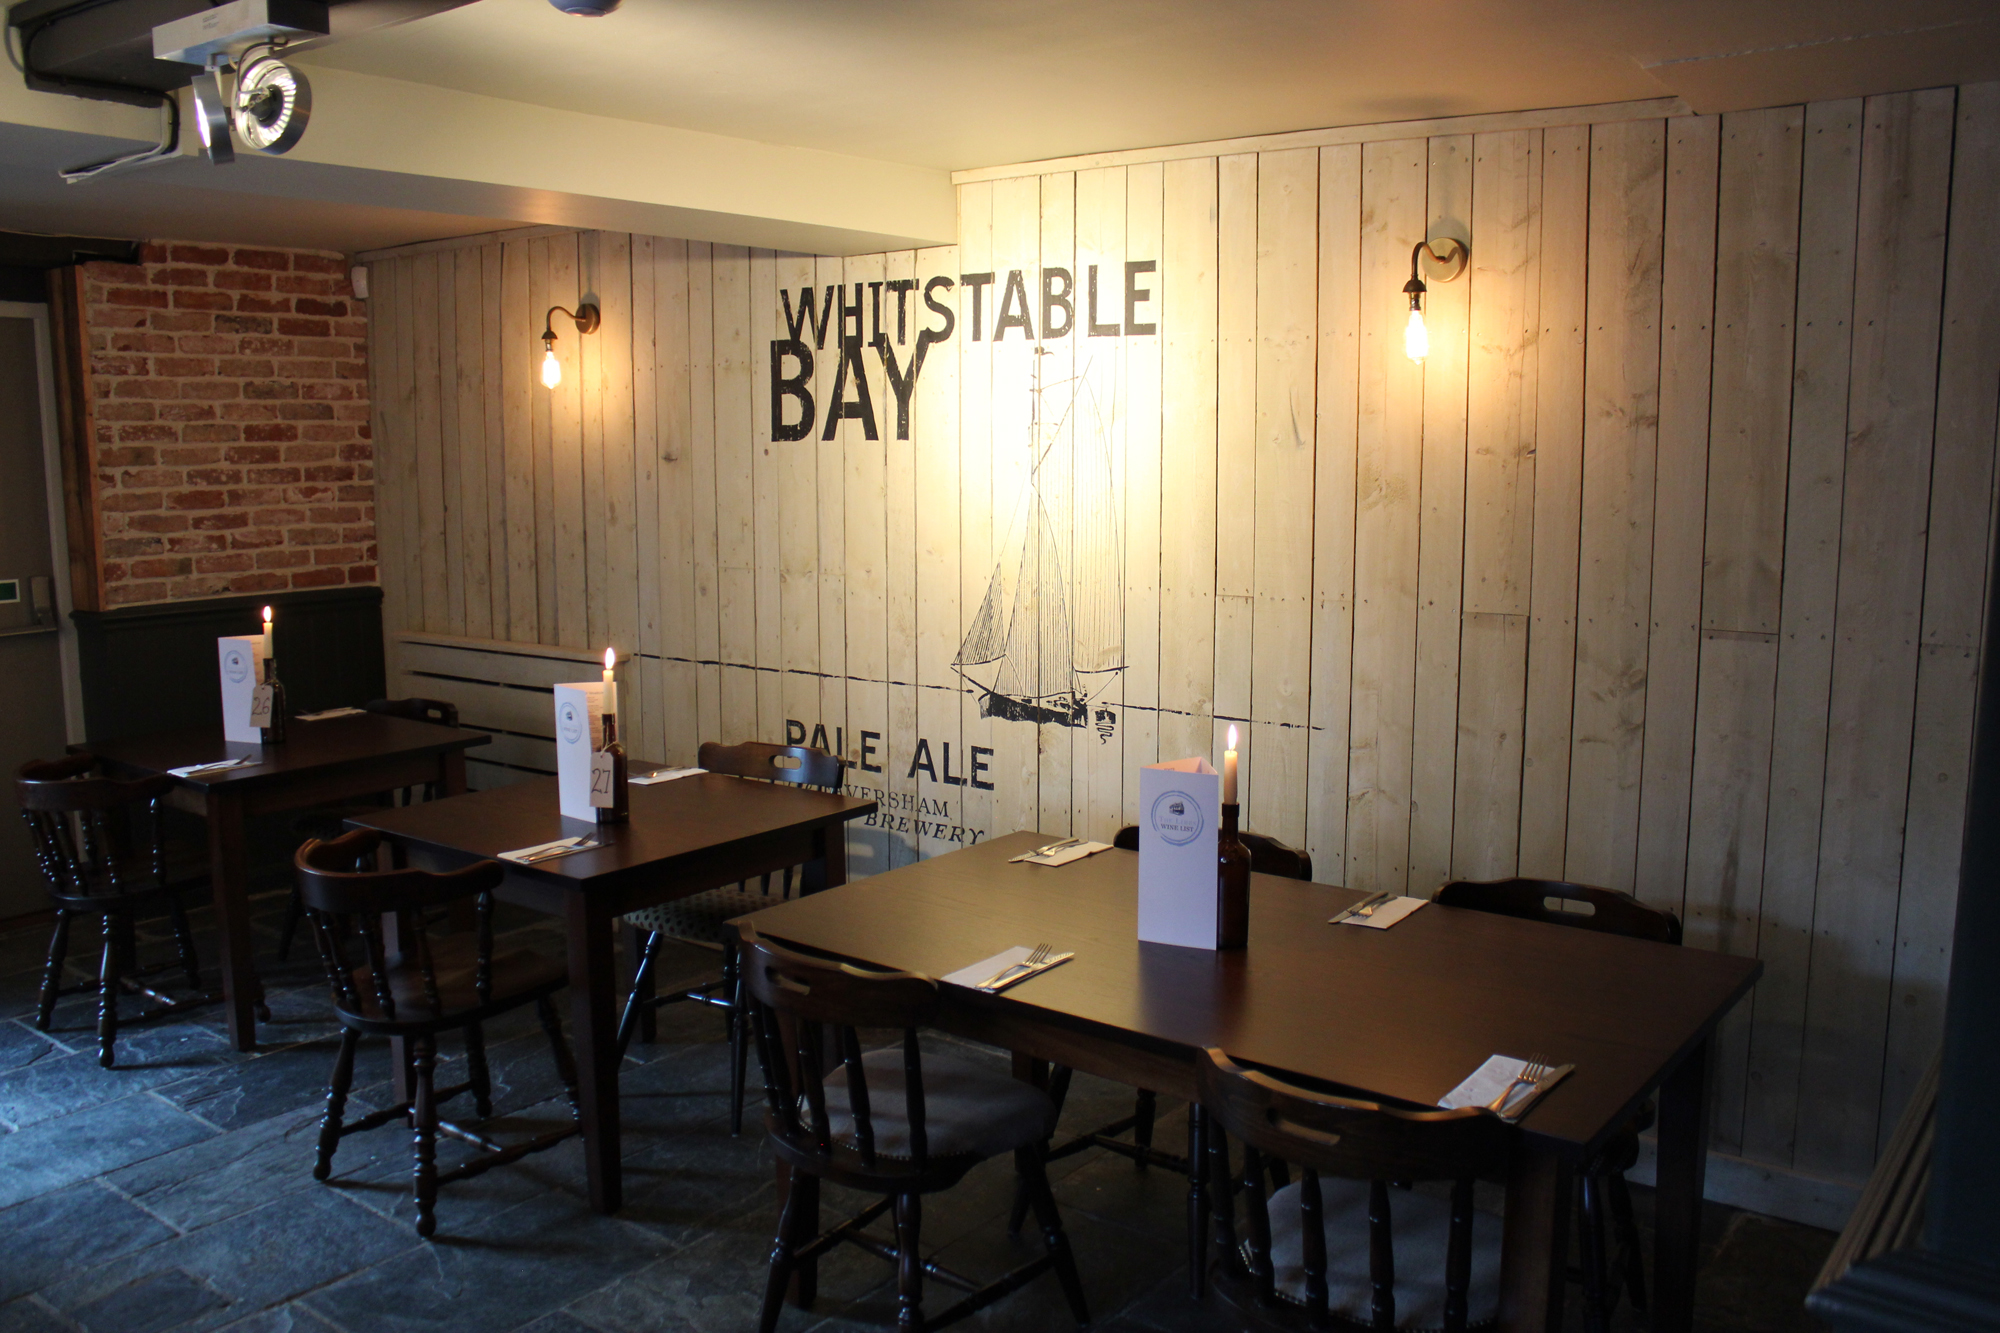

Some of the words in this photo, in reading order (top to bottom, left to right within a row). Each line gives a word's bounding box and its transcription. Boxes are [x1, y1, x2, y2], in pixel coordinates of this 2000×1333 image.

[780, 260, 1157, 350] WHITSTABLE
[770, 330, 929, 442] BAY
[252, 697, 270, 715] 26
[907, 738, 995, 790] ALE
[591, 768, 611, 793] 27
[823, 783, 949, 817] VERSHAM
[864, 814, 985, 845] BREWERY
[1160, 823, 1179, 831] WINE
